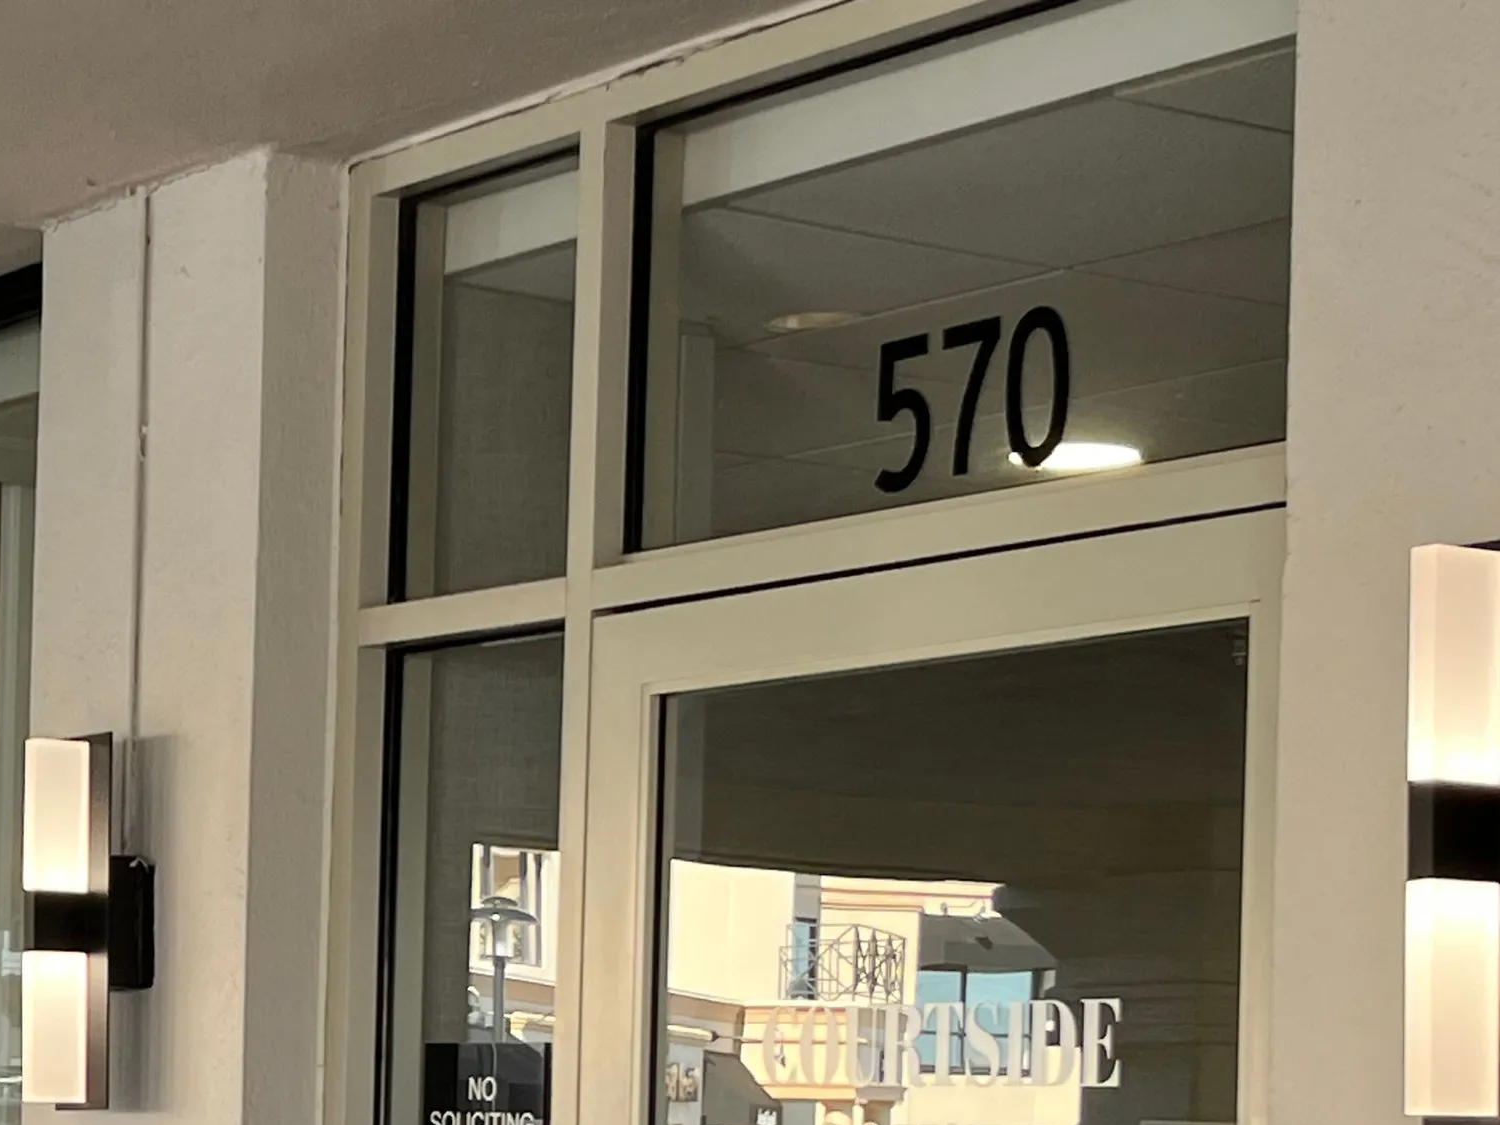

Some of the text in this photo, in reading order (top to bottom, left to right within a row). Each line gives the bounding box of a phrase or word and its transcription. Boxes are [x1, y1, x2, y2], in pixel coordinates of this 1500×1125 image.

[874, 305, 1070, 494] 570
[467, 1076, 498, 1102] NO
[762, 996, 1123, 1089] COURTSIDE
